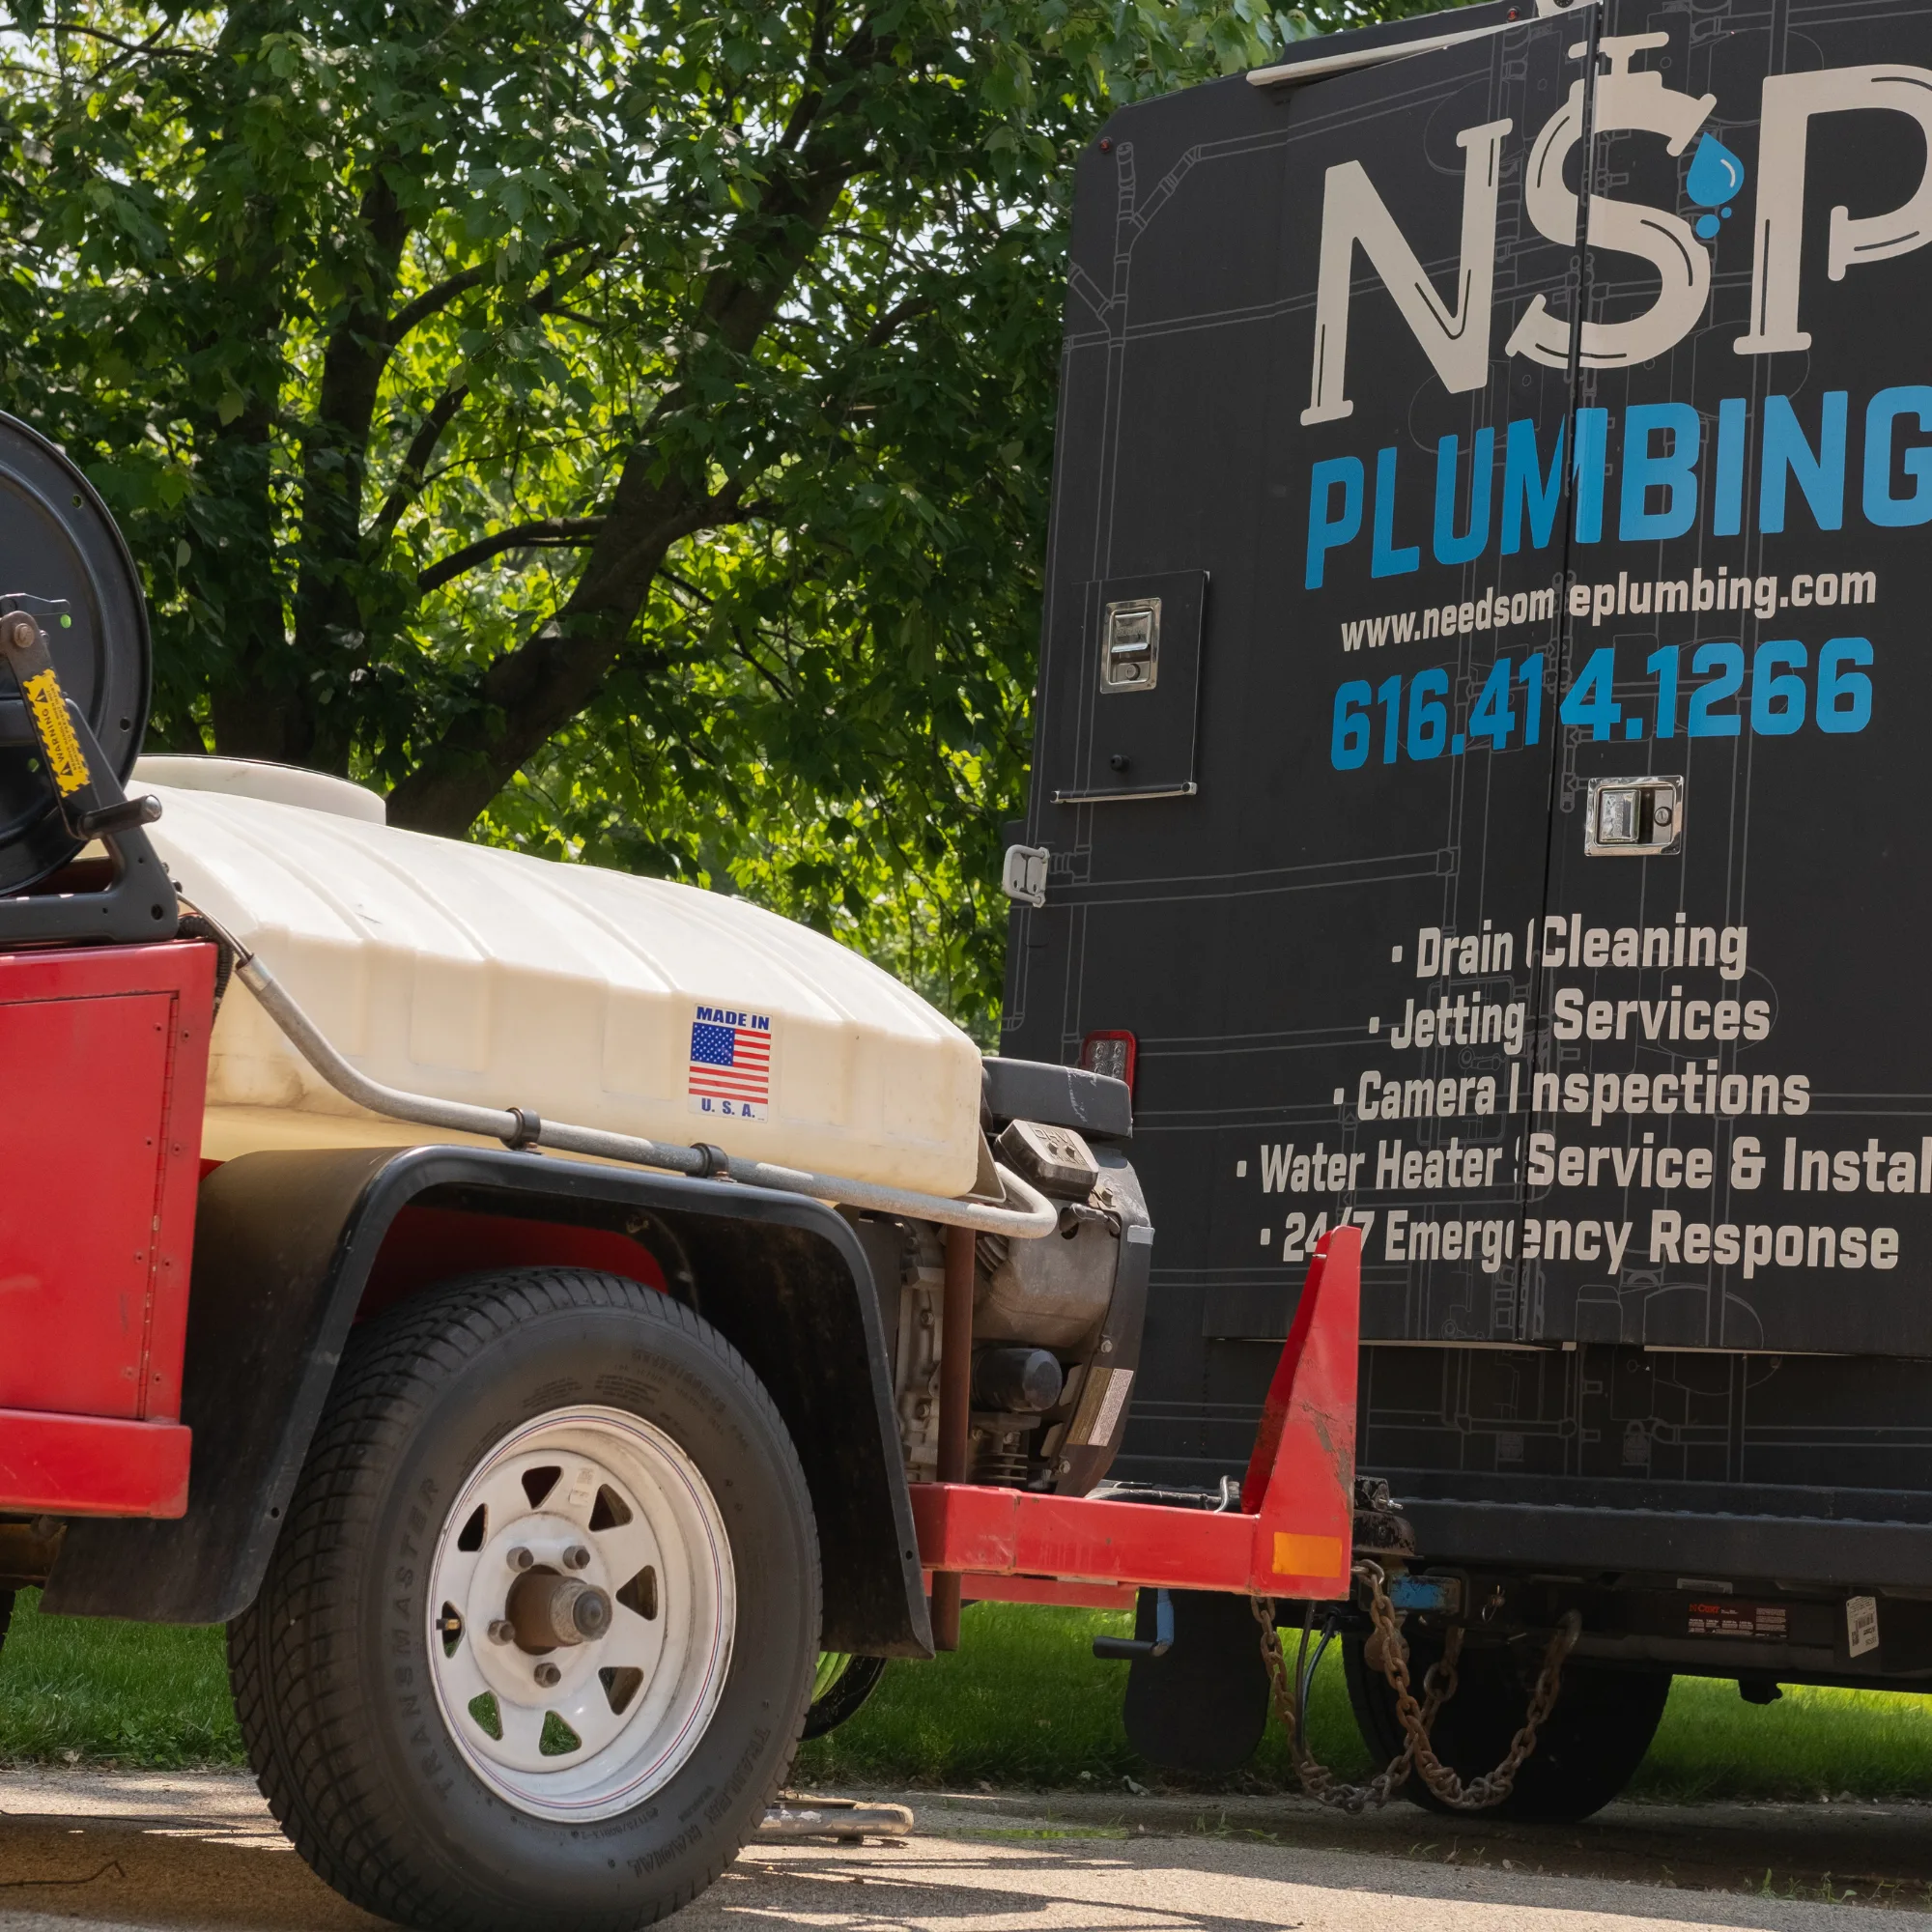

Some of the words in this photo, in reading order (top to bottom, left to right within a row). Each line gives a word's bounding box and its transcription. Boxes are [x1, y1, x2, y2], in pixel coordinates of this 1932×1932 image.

[1300, 32, 1932, 426] NSP
[1305, 386, 1932, 589] PLUMBING
[1342, 566, 1876, 651] www.needsomeplumbing.com
[42, 708, 65, 761] WARNING
[1331, 638, 1873, 770] 616.414.1266
[1417, 920, 1513, 978] Drain
[1526, 913, 1747, 980] Cleaning
[696, 1006, 747, 1027] MADE
[752, 1015, 770, 1030] IN
[1391, 991, 1524, 1055] Jetting
[1554, 985, 1770, 1039] Services
[1358, 1071, 1495, 1121] Camera
[1509, 1060, 1809, 1125] Inspections
[1262, 1143, 1365, 1192] Water
[1376, 1138, 1502, 1189] Heater
[1516, 1133, 1712, 1188] Service
[1731, 1137, 1766, 1189] &
[1385, 1210, 1633, 1274] Emergency
[1650, 1209, 1898, 1278] Response
[393, 1476, 454, 1803] TRANSMASTER
[703, 1725, 772, 1827] TRAILER
[627, 1823, 702, 1878] RADIAL
